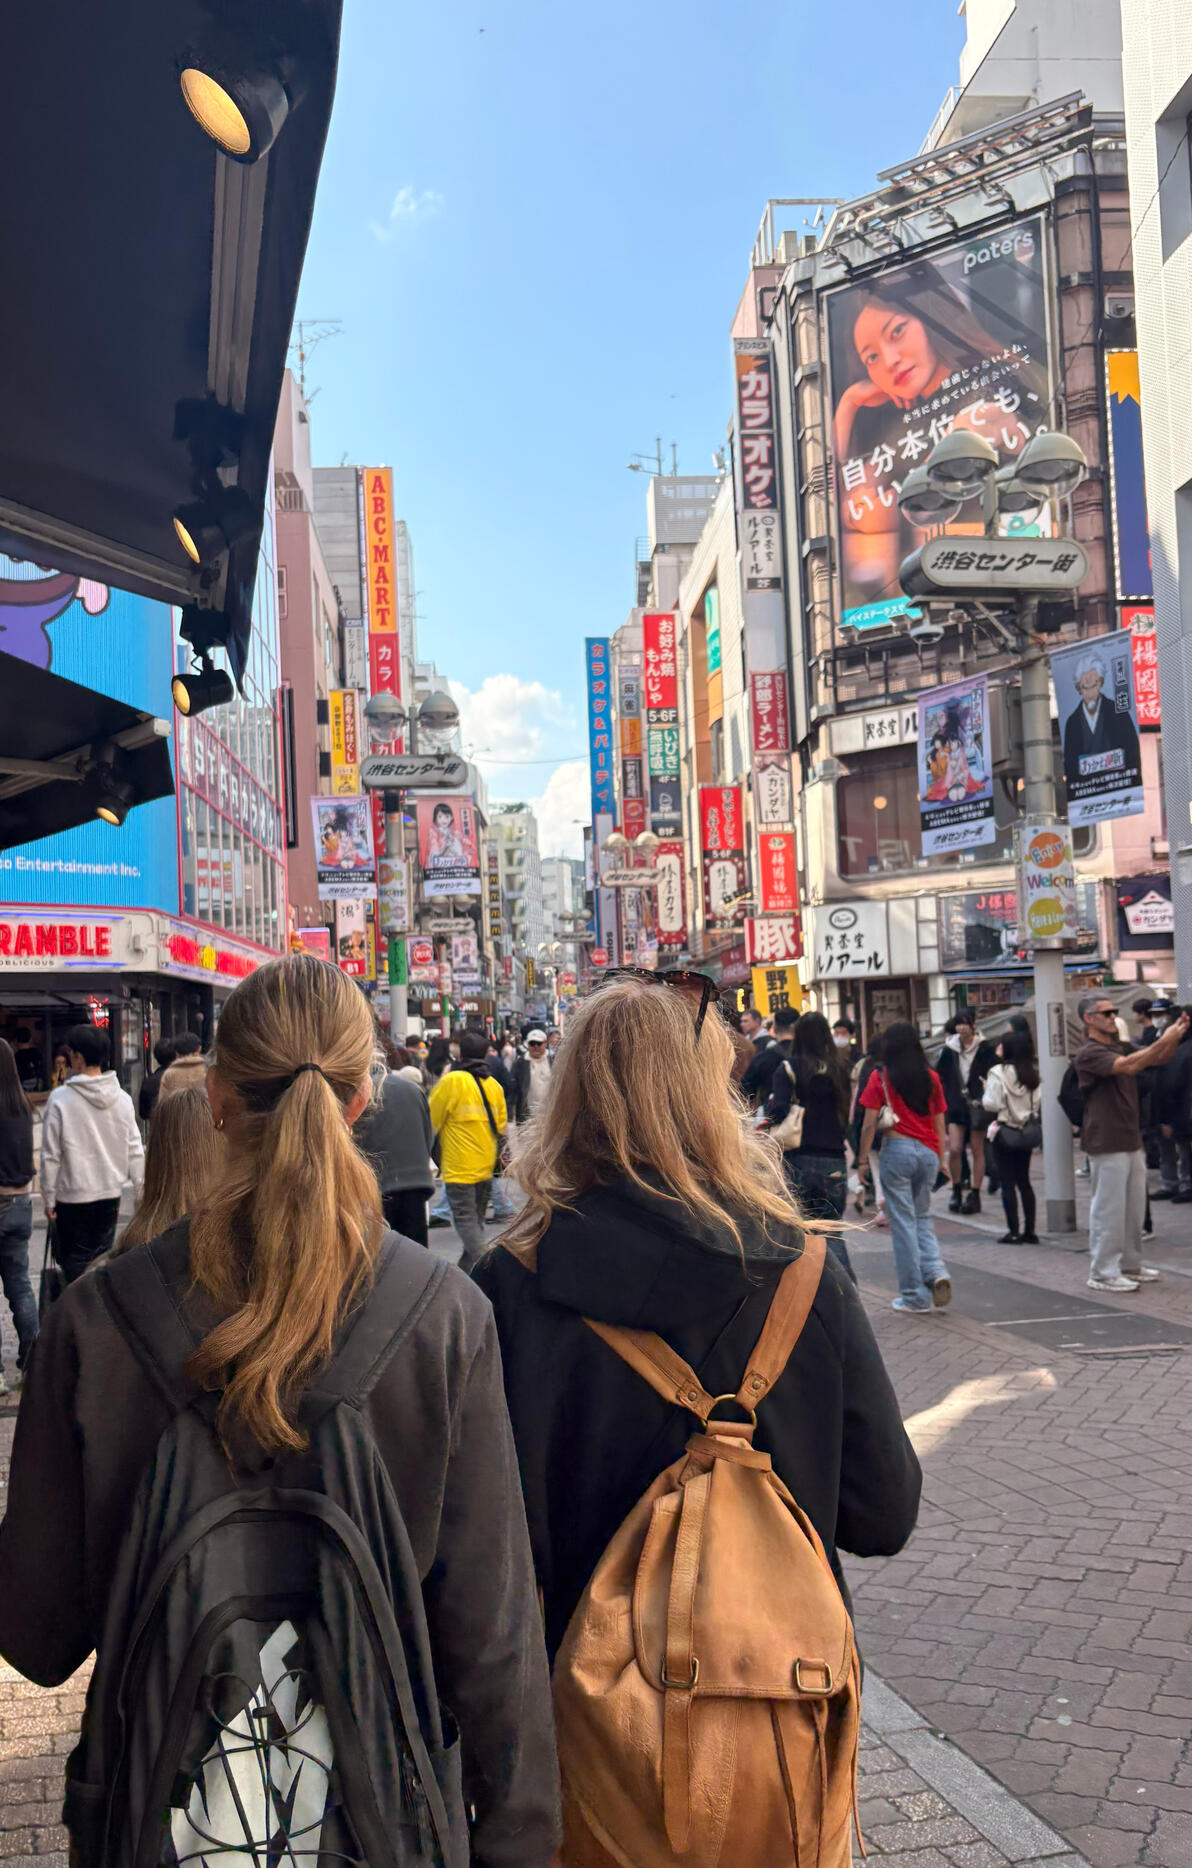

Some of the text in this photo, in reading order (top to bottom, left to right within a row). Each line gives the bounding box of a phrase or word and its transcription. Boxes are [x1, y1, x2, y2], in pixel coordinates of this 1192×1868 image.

[964, 232, 1033, 274] paters
[740, 371, 774, 497] カラオケ
[842, 385, 1039, 492] 自分本位でも、
[746, 516, 762, 575] ルノアール
[931, 550, 1078, 573] 渋谷センター街
[757, 579, 771, 589] 2F
[849, 603, 906, 624] ハイステータスマ
[658, 620, 675, 677] お好み焼
[647, 649, 663, 704] もんじゃ
[865, 719, 897, 741] 喫茶室
[649, 730, 664, 769] 無呼吸
[663, 730, 678, 769] いびき
[366, 763, 461, 777] 渋谷センター街
[16, 856, 118, 875] Entertainment
[120, 862, 141, 877] Inc.
[1030, 841, 1064, 864] Enjoy
[1027, 873, 1075, 890] Welcom
[0, 924, 112, 957] RAMBLE
[754, 918, 797, 960] 豚
[824, 933, 865, 951] 喫茶室
[765, 970, 790, 1013] 野郎
